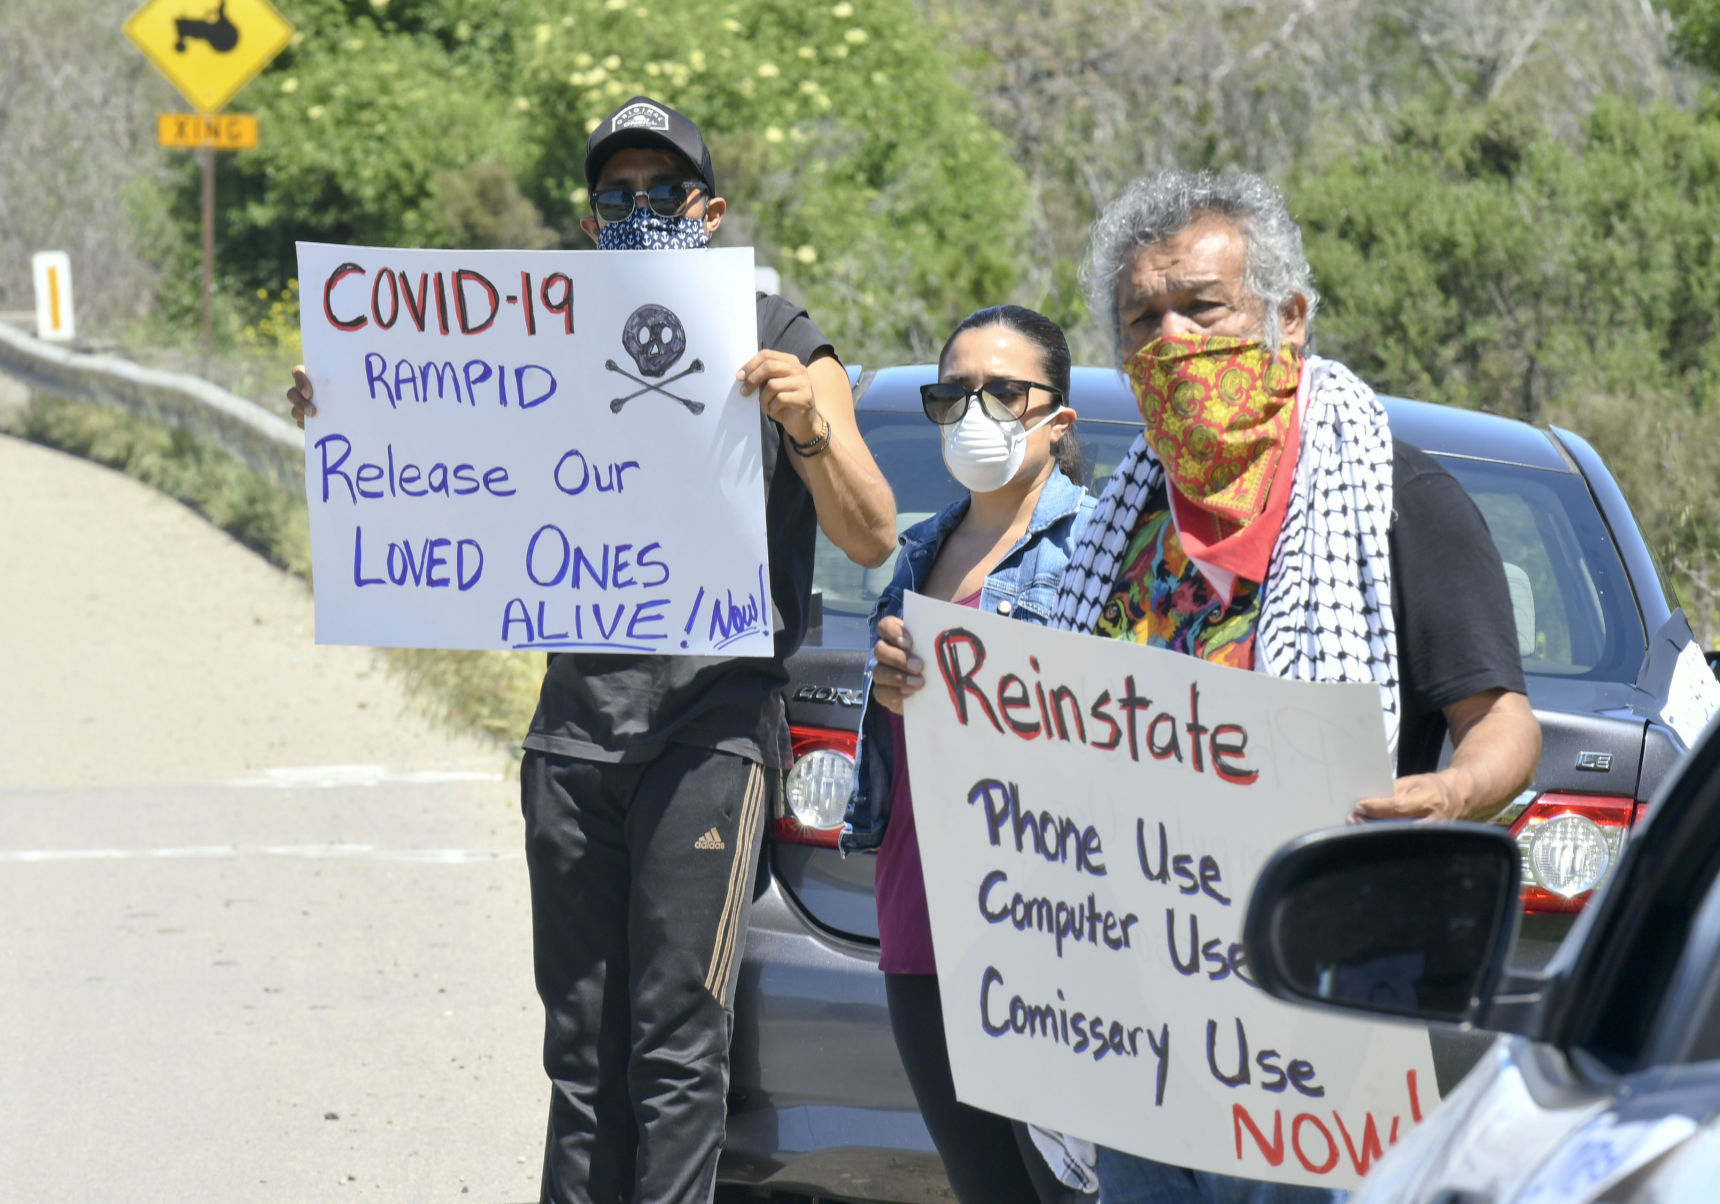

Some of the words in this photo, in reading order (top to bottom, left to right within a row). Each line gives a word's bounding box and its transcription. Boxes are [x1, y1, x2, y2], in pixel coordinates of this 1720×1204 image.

[174, 119, 244, 141] XING
[323, 263, 574, 336] COVID-19
[365, 352, 557, 409] RAMPID
[314, 433, 516, 504] Release
[554, 448, 641, 495] Our
[354, 526, 483, 591] LOVED
[526, 524, 670, 590] ONES
[709, 563, 769, 641] Now!
[934, 627, 1259, 785] Reinstate
[1577, 751, 1611, 770] LE
[694, 841, 726, 850] adidas
[968, 778, 1107, 877] Phone
[1136, 818, 1231, 906] Use
[978, 870, 1138, 958] Computer
[980, 966, 1169, 1107] Comissary
[1206, 1017, 1325, 1098] Use
